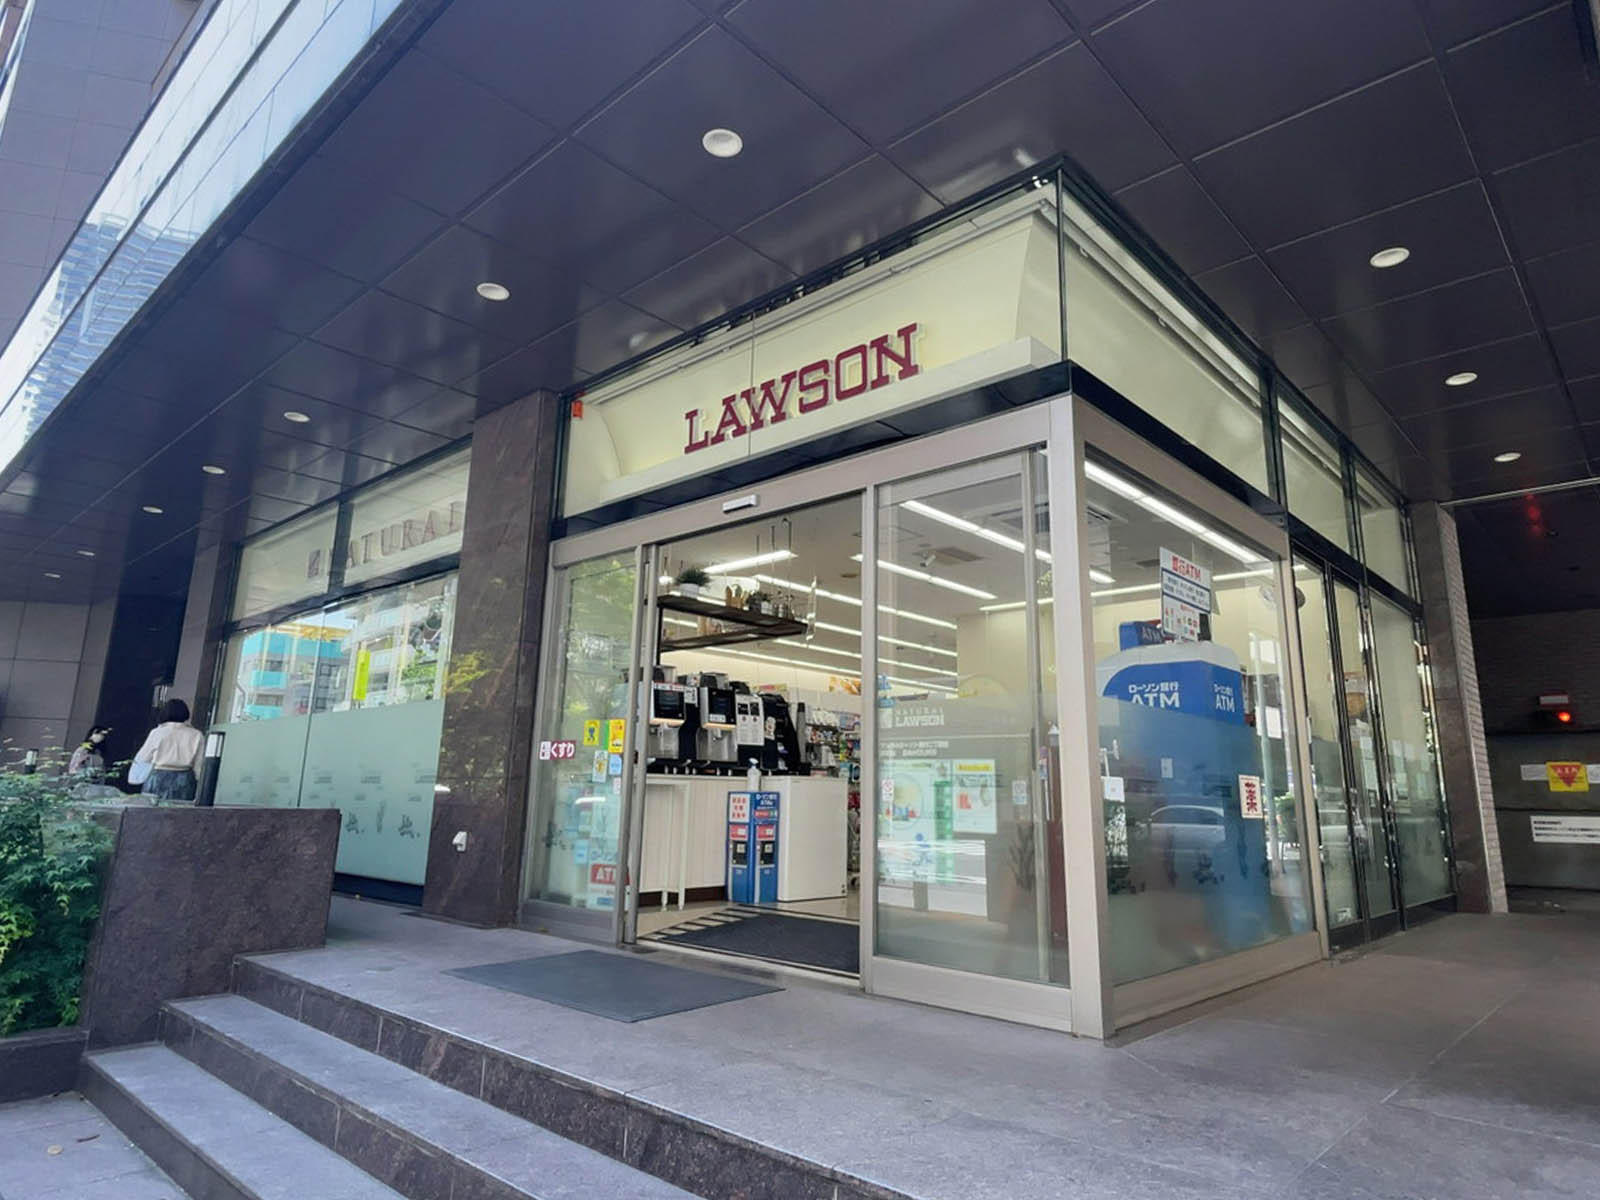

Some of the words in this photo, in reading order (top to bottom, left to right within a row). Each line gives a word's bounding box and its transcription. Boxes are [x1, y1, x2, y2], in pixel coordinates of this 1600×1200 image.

[684, 322, 920, 455] LAWSON
[328, 500, 464, 577] ATURAL
[1131, 692, 1180, 708] ATM
[1215, 693, 1236, 713] ATM
[895, 714, 945, 728] LAWSON
[551, 742, 575, 758] くすり
